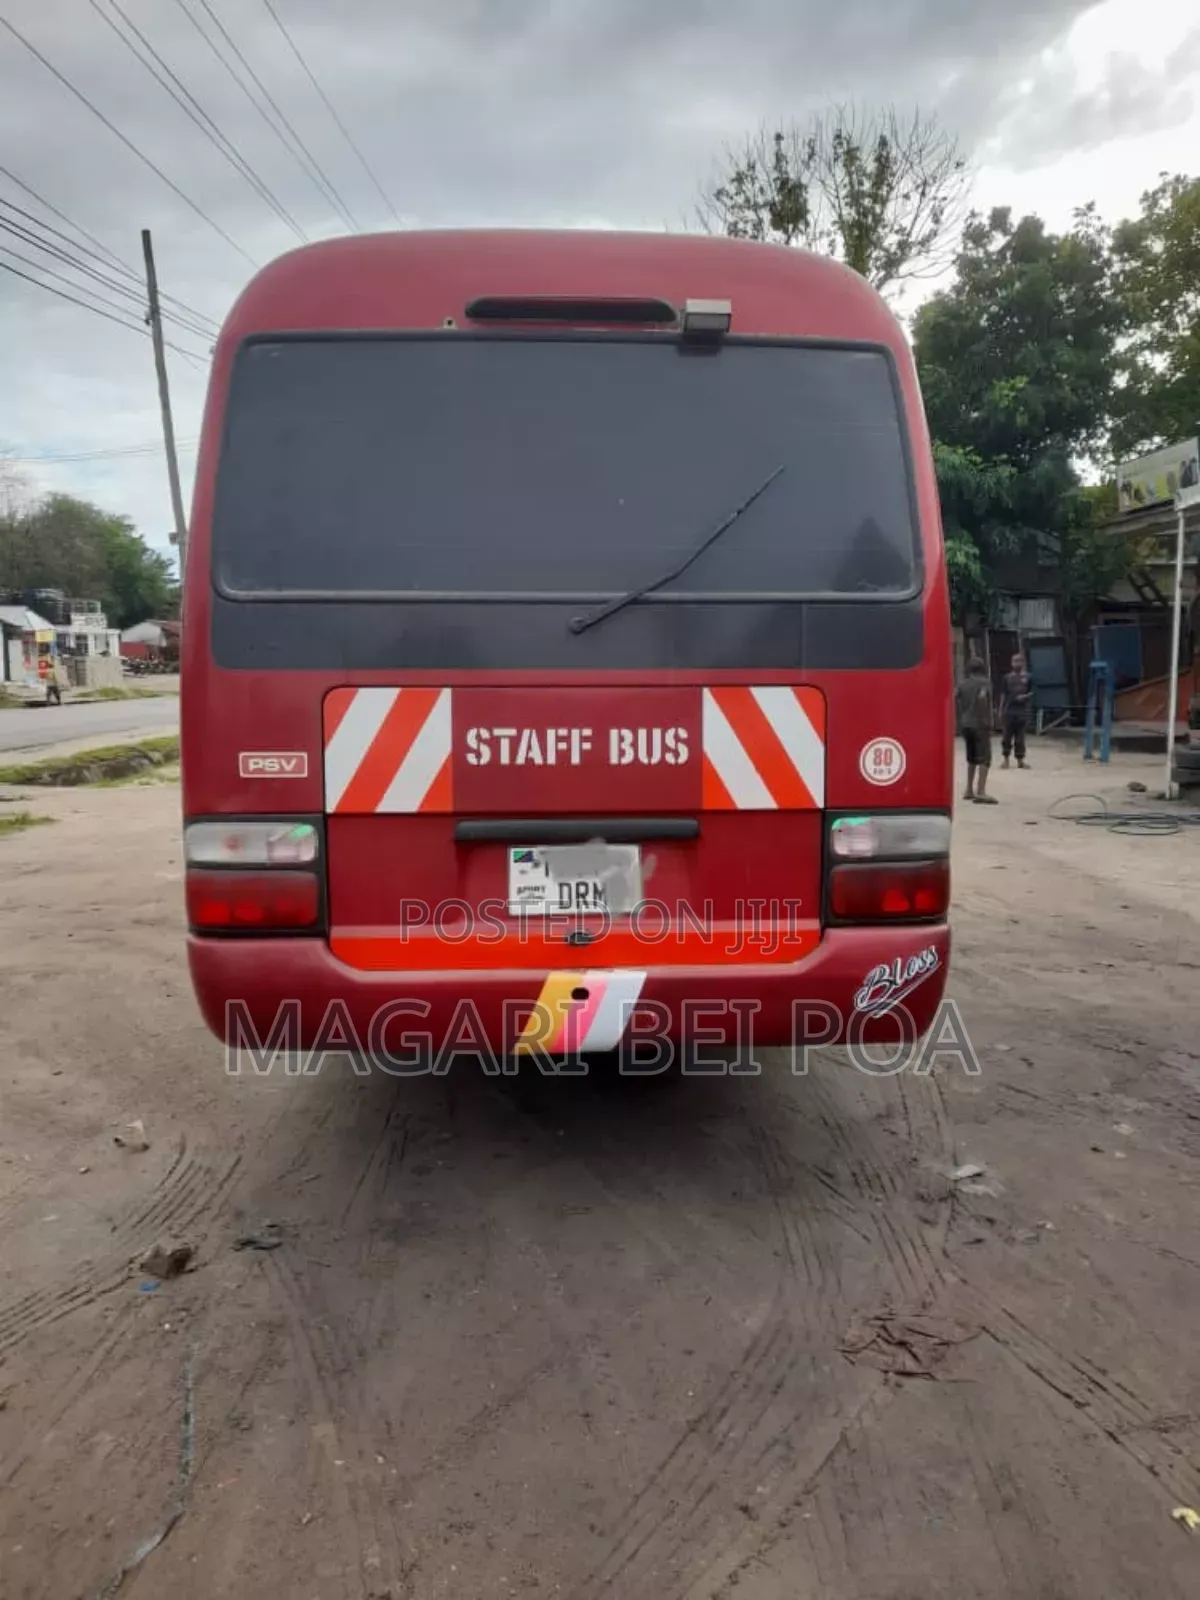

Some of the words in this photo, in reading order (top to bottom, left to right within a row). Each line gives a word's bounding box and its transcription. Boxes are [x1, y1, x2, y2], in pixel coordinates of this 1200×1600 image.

[466, 727, 593, 766] STAFF
[609, 727, 690, 766] BUS
[248, 757, 297, 772] PSV
[873, 747, 893, 766] 80
